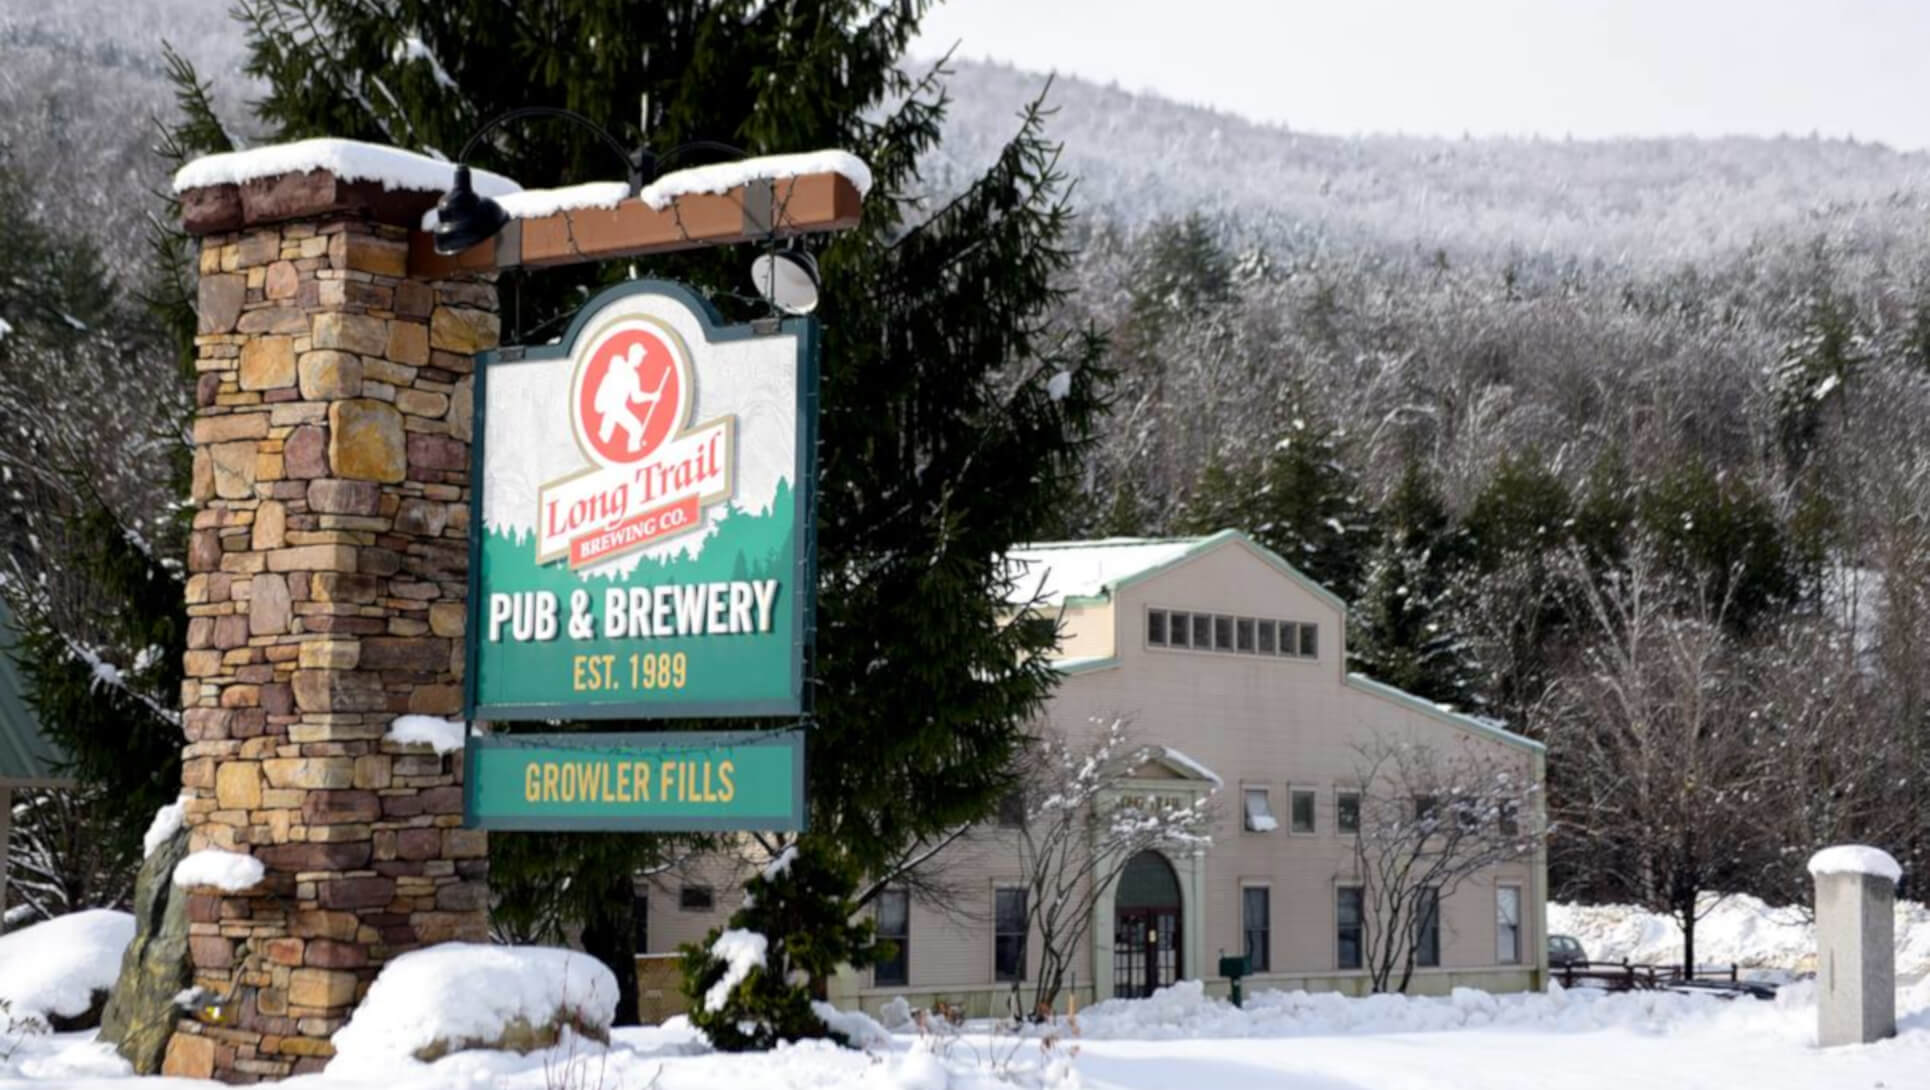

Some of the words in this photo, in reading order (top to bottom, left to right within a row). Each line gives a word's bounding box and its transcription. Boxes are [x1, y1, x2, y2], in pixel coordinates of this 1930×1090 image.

[546, 482, 629, 538] Long
[635, 431, 722, 502] Trail
[579, 518, 656, 558] BREWING
[661, 508, 688, 531] CO.
[489, 592, 557, 641] PUB
[569, 589, 593, 639] &
[604, 580, 777, 638] BREWERY
[573, 655, 619, 691] EST.
[630, 652, 687, 689] 1989
[525, 762, 649, 802] GROWLER
[661, 760, 735, 802] FILLS
